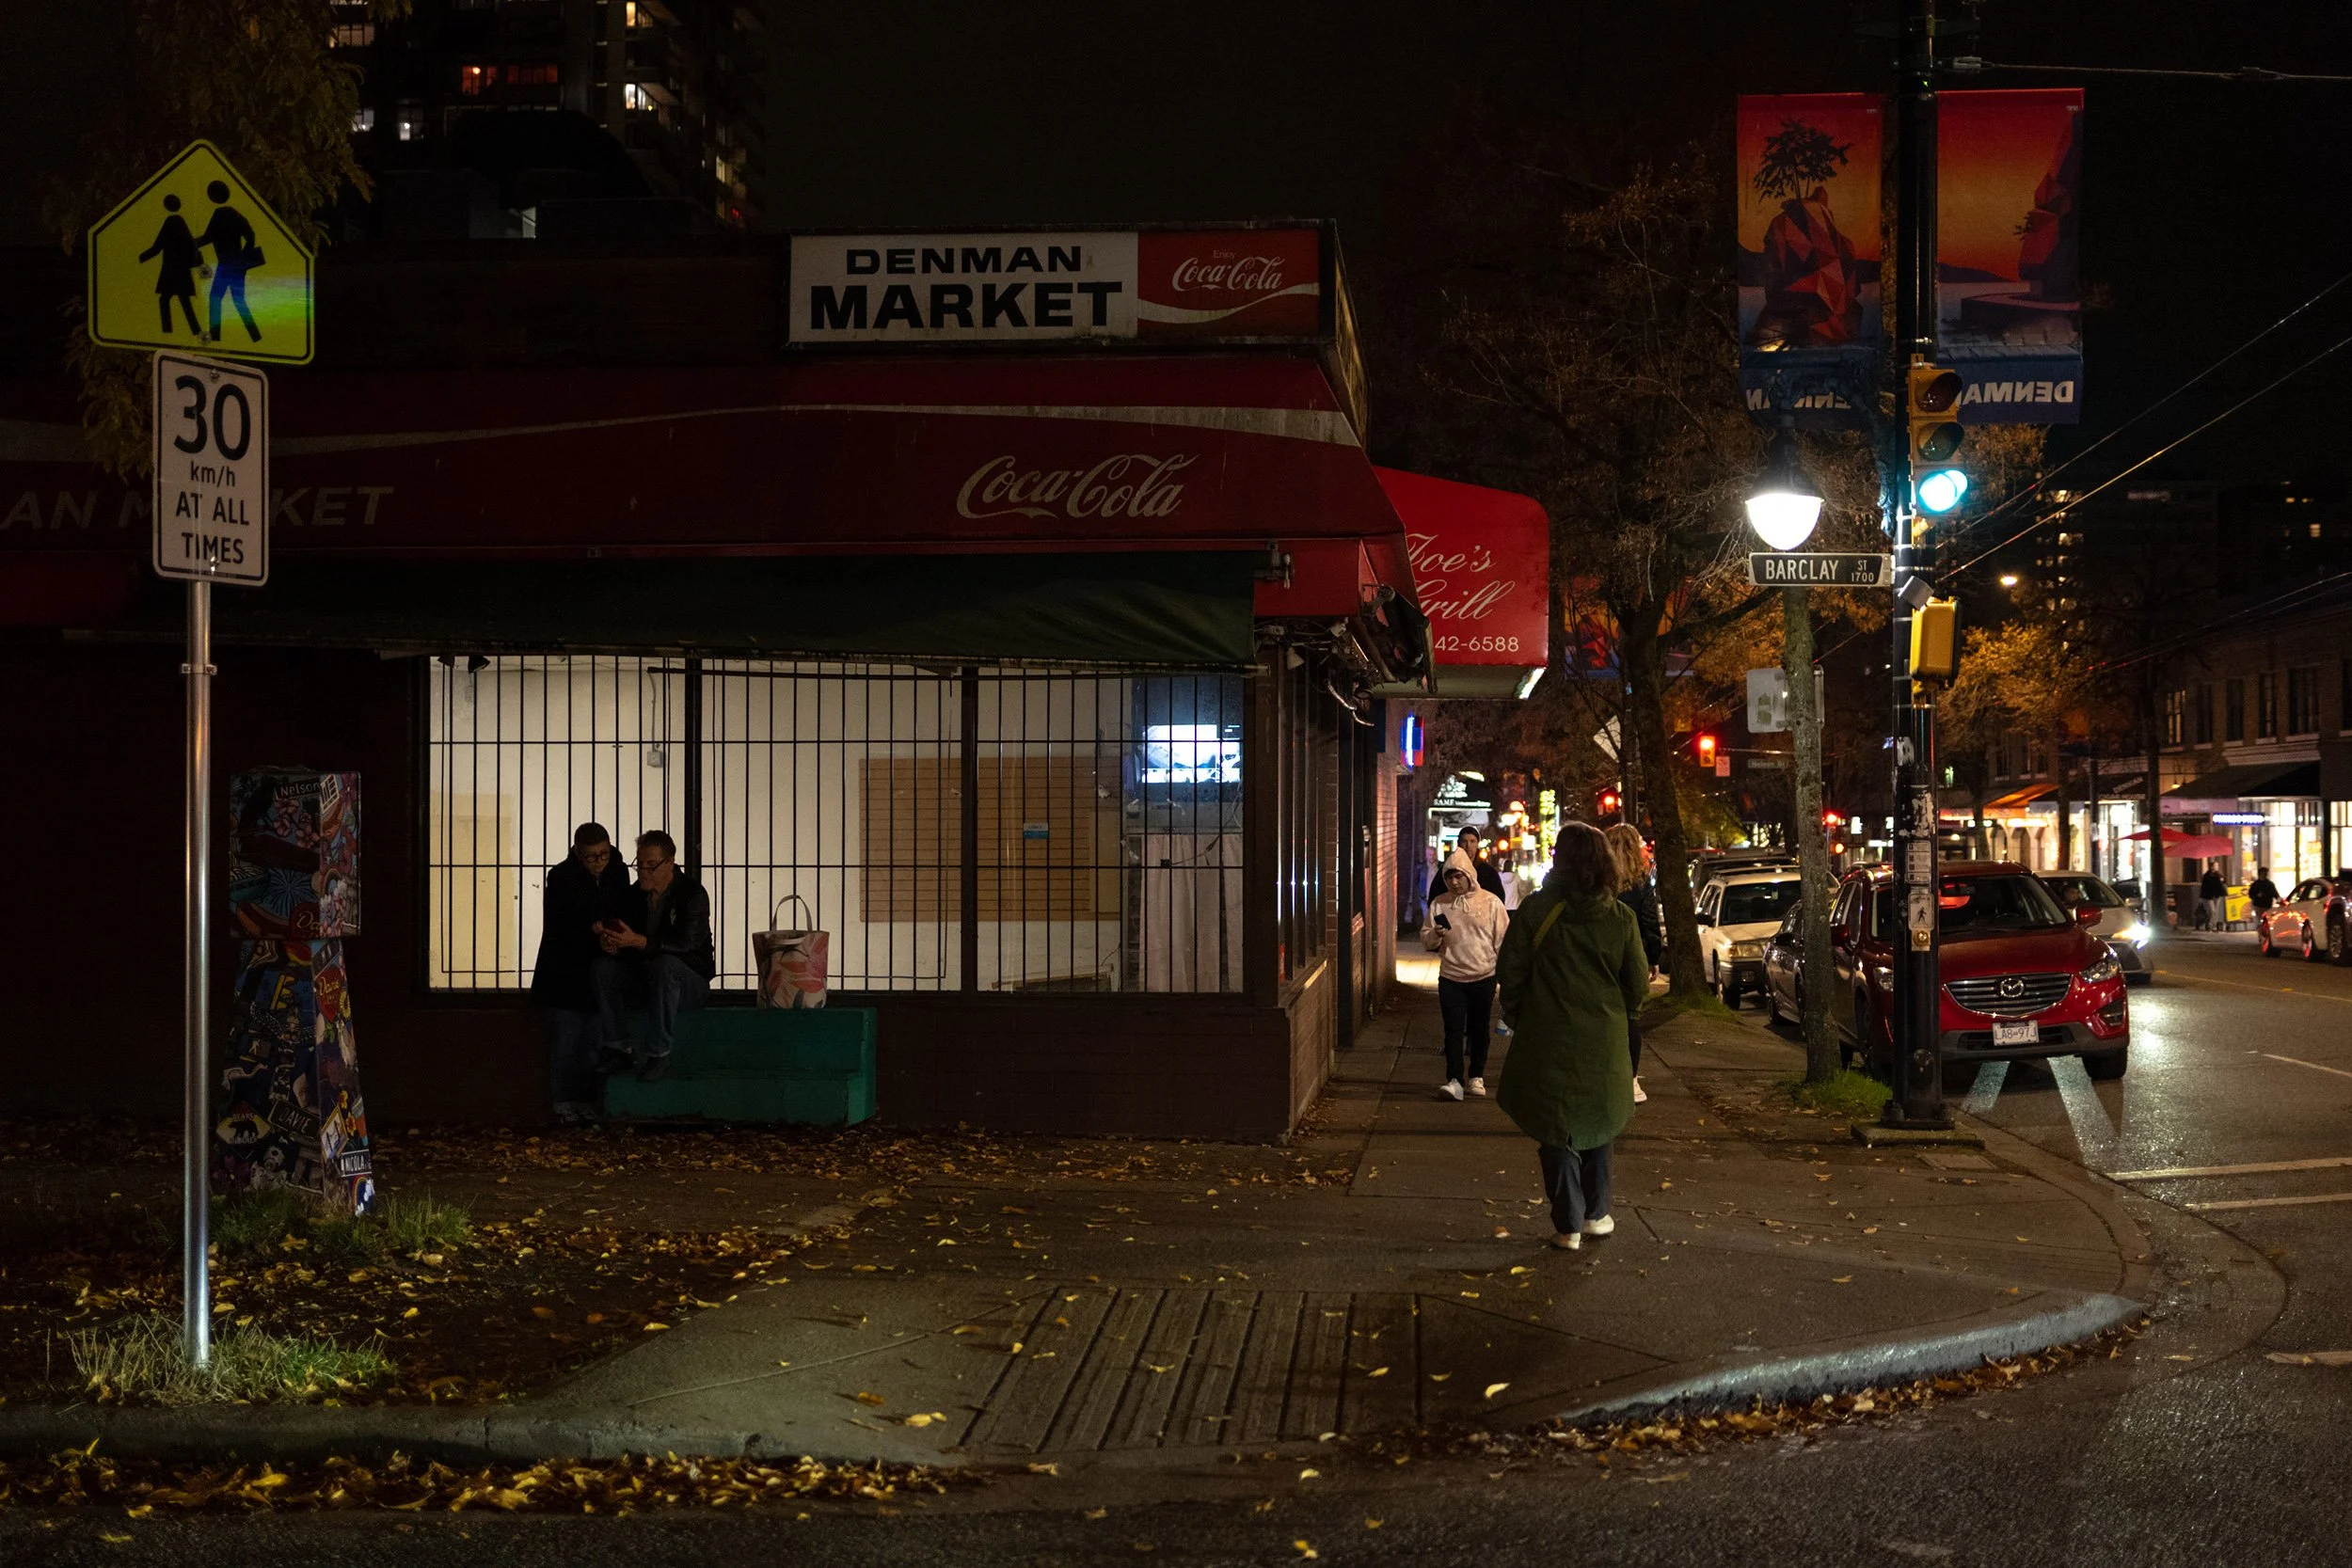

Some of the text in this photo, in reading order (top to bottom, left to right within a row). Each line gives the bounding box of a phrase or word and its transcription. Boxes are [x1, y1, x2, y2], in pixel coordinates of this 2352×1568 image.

[847, 245, 1081, 275] DENMAN
[1213, 250, 1236, 261] Enjoy
[1172, 256, 1286, 292] Coca-Cola
[811, 281, 1122, 329] MARKET
[174, 374, 251, 461] 30
[191, 461, 235, 487] km/h
[957, 453, 1200, 518] Coca-Cola
[116, 485, 395, 531] MKET
[176, 491, 249, 525] AT ALL
[182, 532, 244, 564] TIMES
[1406, 533, 1497, 572] Joe's
[1765, 560, 1867, 580] BARCLAY ST
[1851, 572, 1874, 583] 1700
[280, 782, 320, 797] Nelson
[278, 1107, 312, 1134] DAVIE
